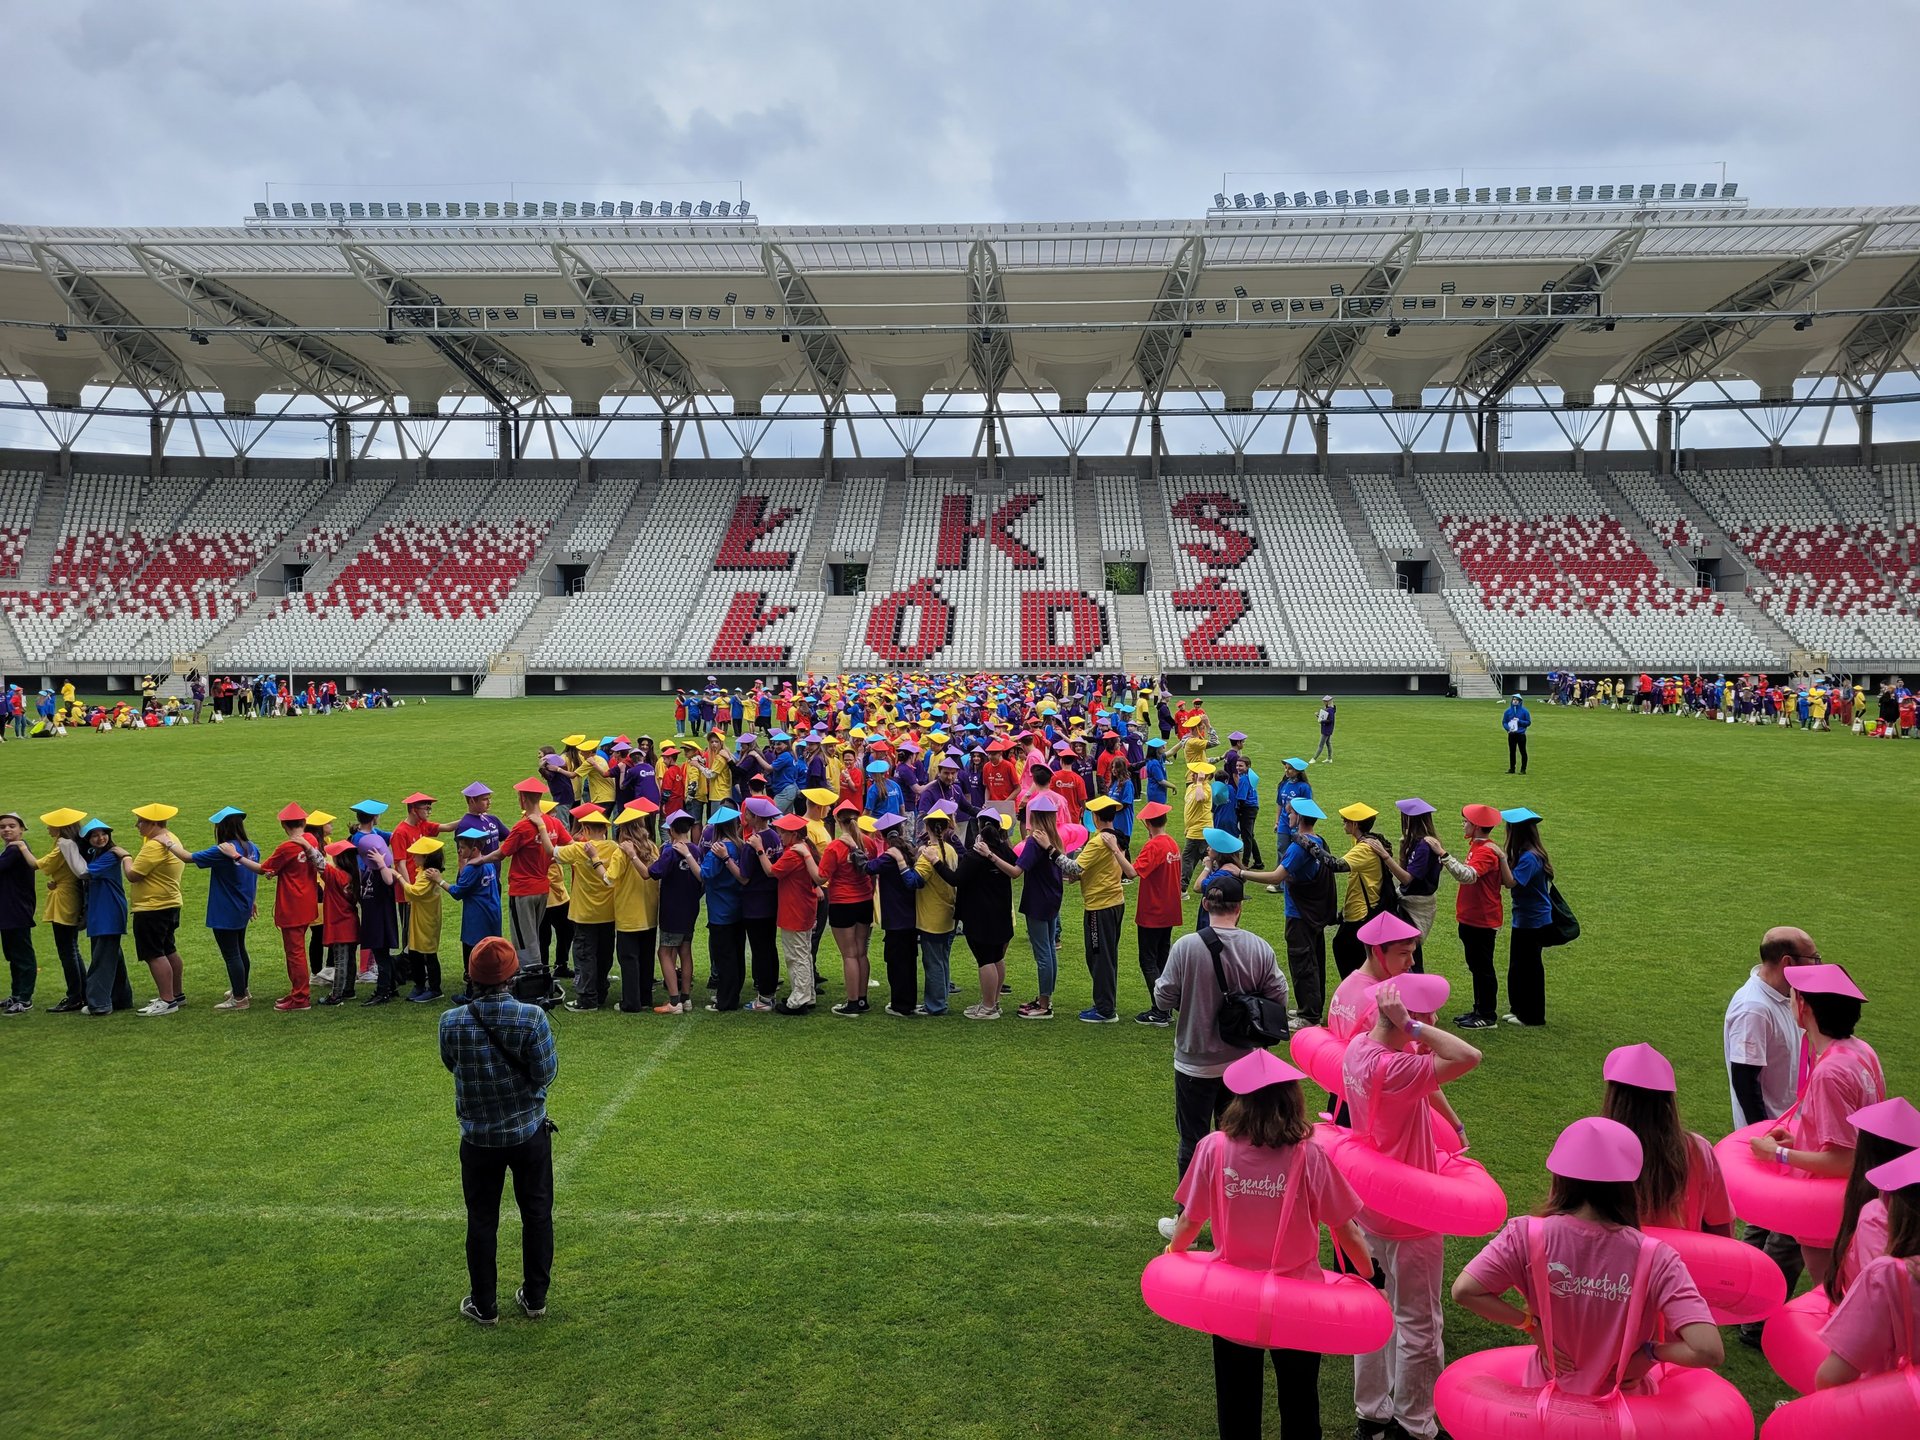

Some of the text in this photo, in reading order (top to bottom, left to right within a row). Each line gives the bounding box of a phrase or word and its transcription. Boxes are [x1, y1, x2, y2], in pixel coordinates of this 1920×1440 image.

[1120, 550, 1131, 558] F3
[1402, 548, 1413, 557] F2
[1693, 545, 1704, 554] F1
[298, 552, 309, 560] F6
[571, 552, 582, 560] F5
[844, 551, 855, 560] F4
[1580, 1289, 1608, 1299] RATUJE
